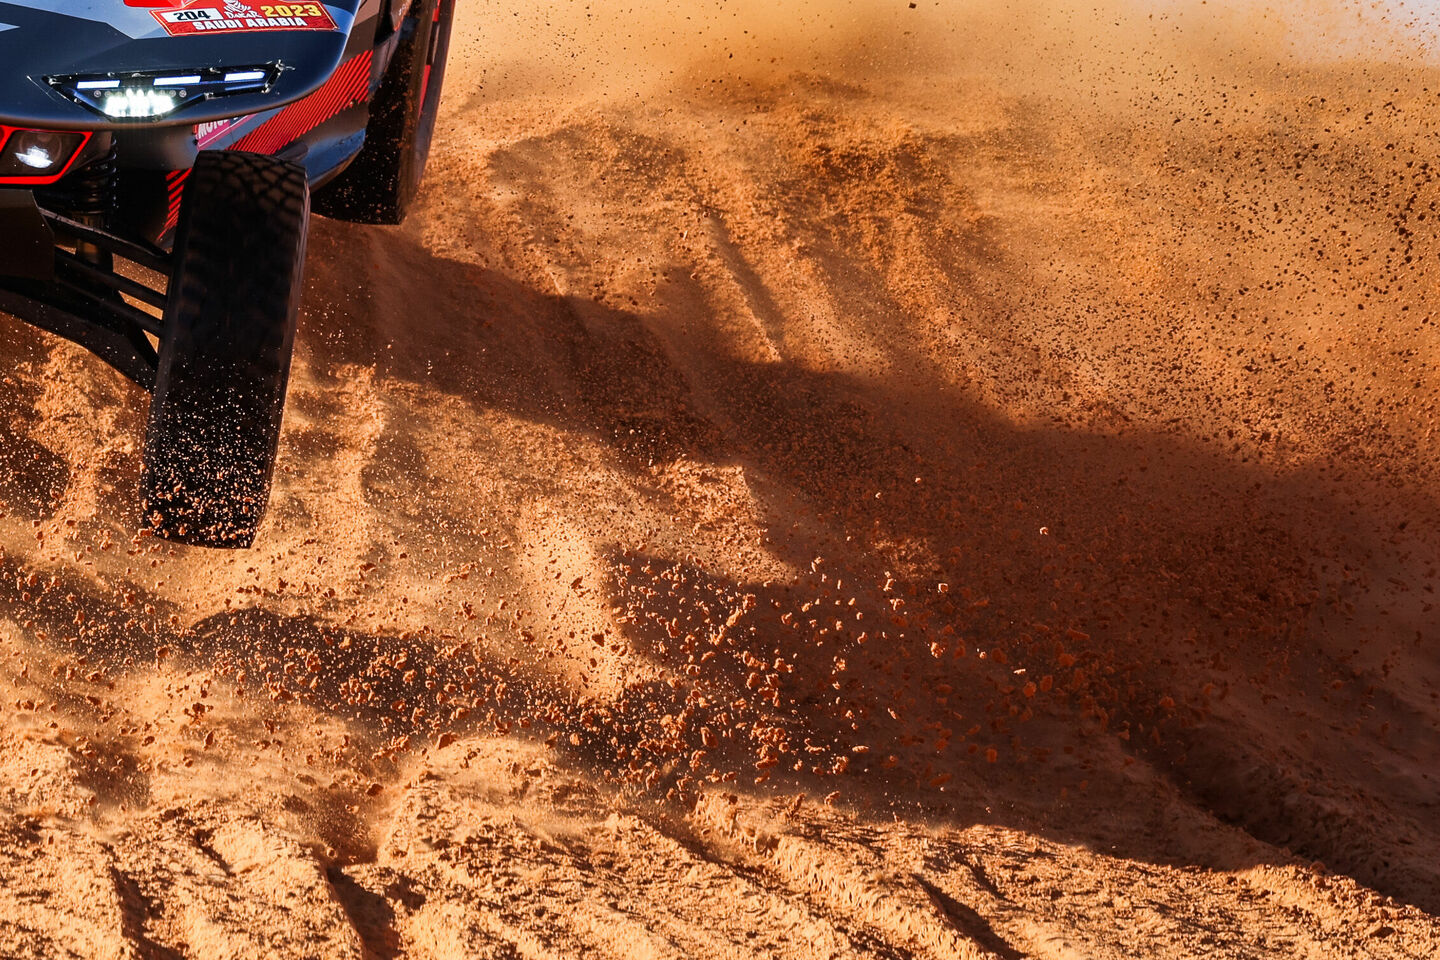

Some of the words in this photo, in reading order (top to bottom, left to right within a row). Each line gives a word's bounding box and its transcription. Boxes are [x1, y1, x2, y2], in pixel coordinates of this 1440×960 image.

[173, 10, 211, 21] 204
[224, 10, 262, 19] DAKAR
[261, 4, 322, 17] 2023
[192, 19, 242, 30] SAUDI
[246, 17, 307, 29] ARABIA
